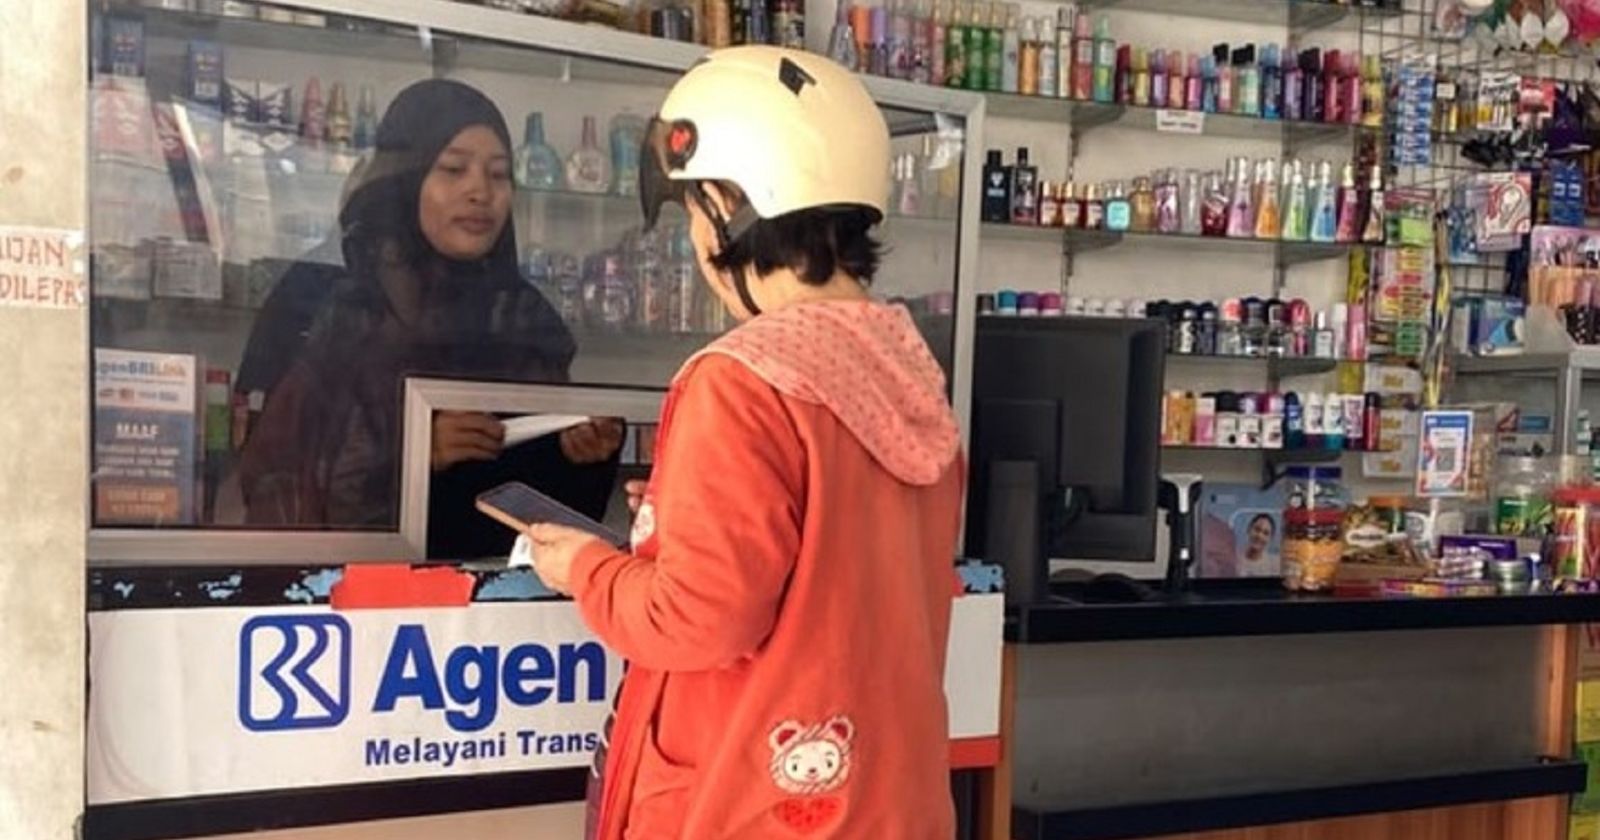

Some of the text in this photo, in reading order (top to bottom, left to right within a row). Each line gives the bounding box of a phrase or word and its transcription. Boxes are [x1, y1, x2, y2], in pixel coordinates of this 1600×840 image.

[371, 624, 606, 732] Agen
[365, 730, 599, 766] Melayani Trans
